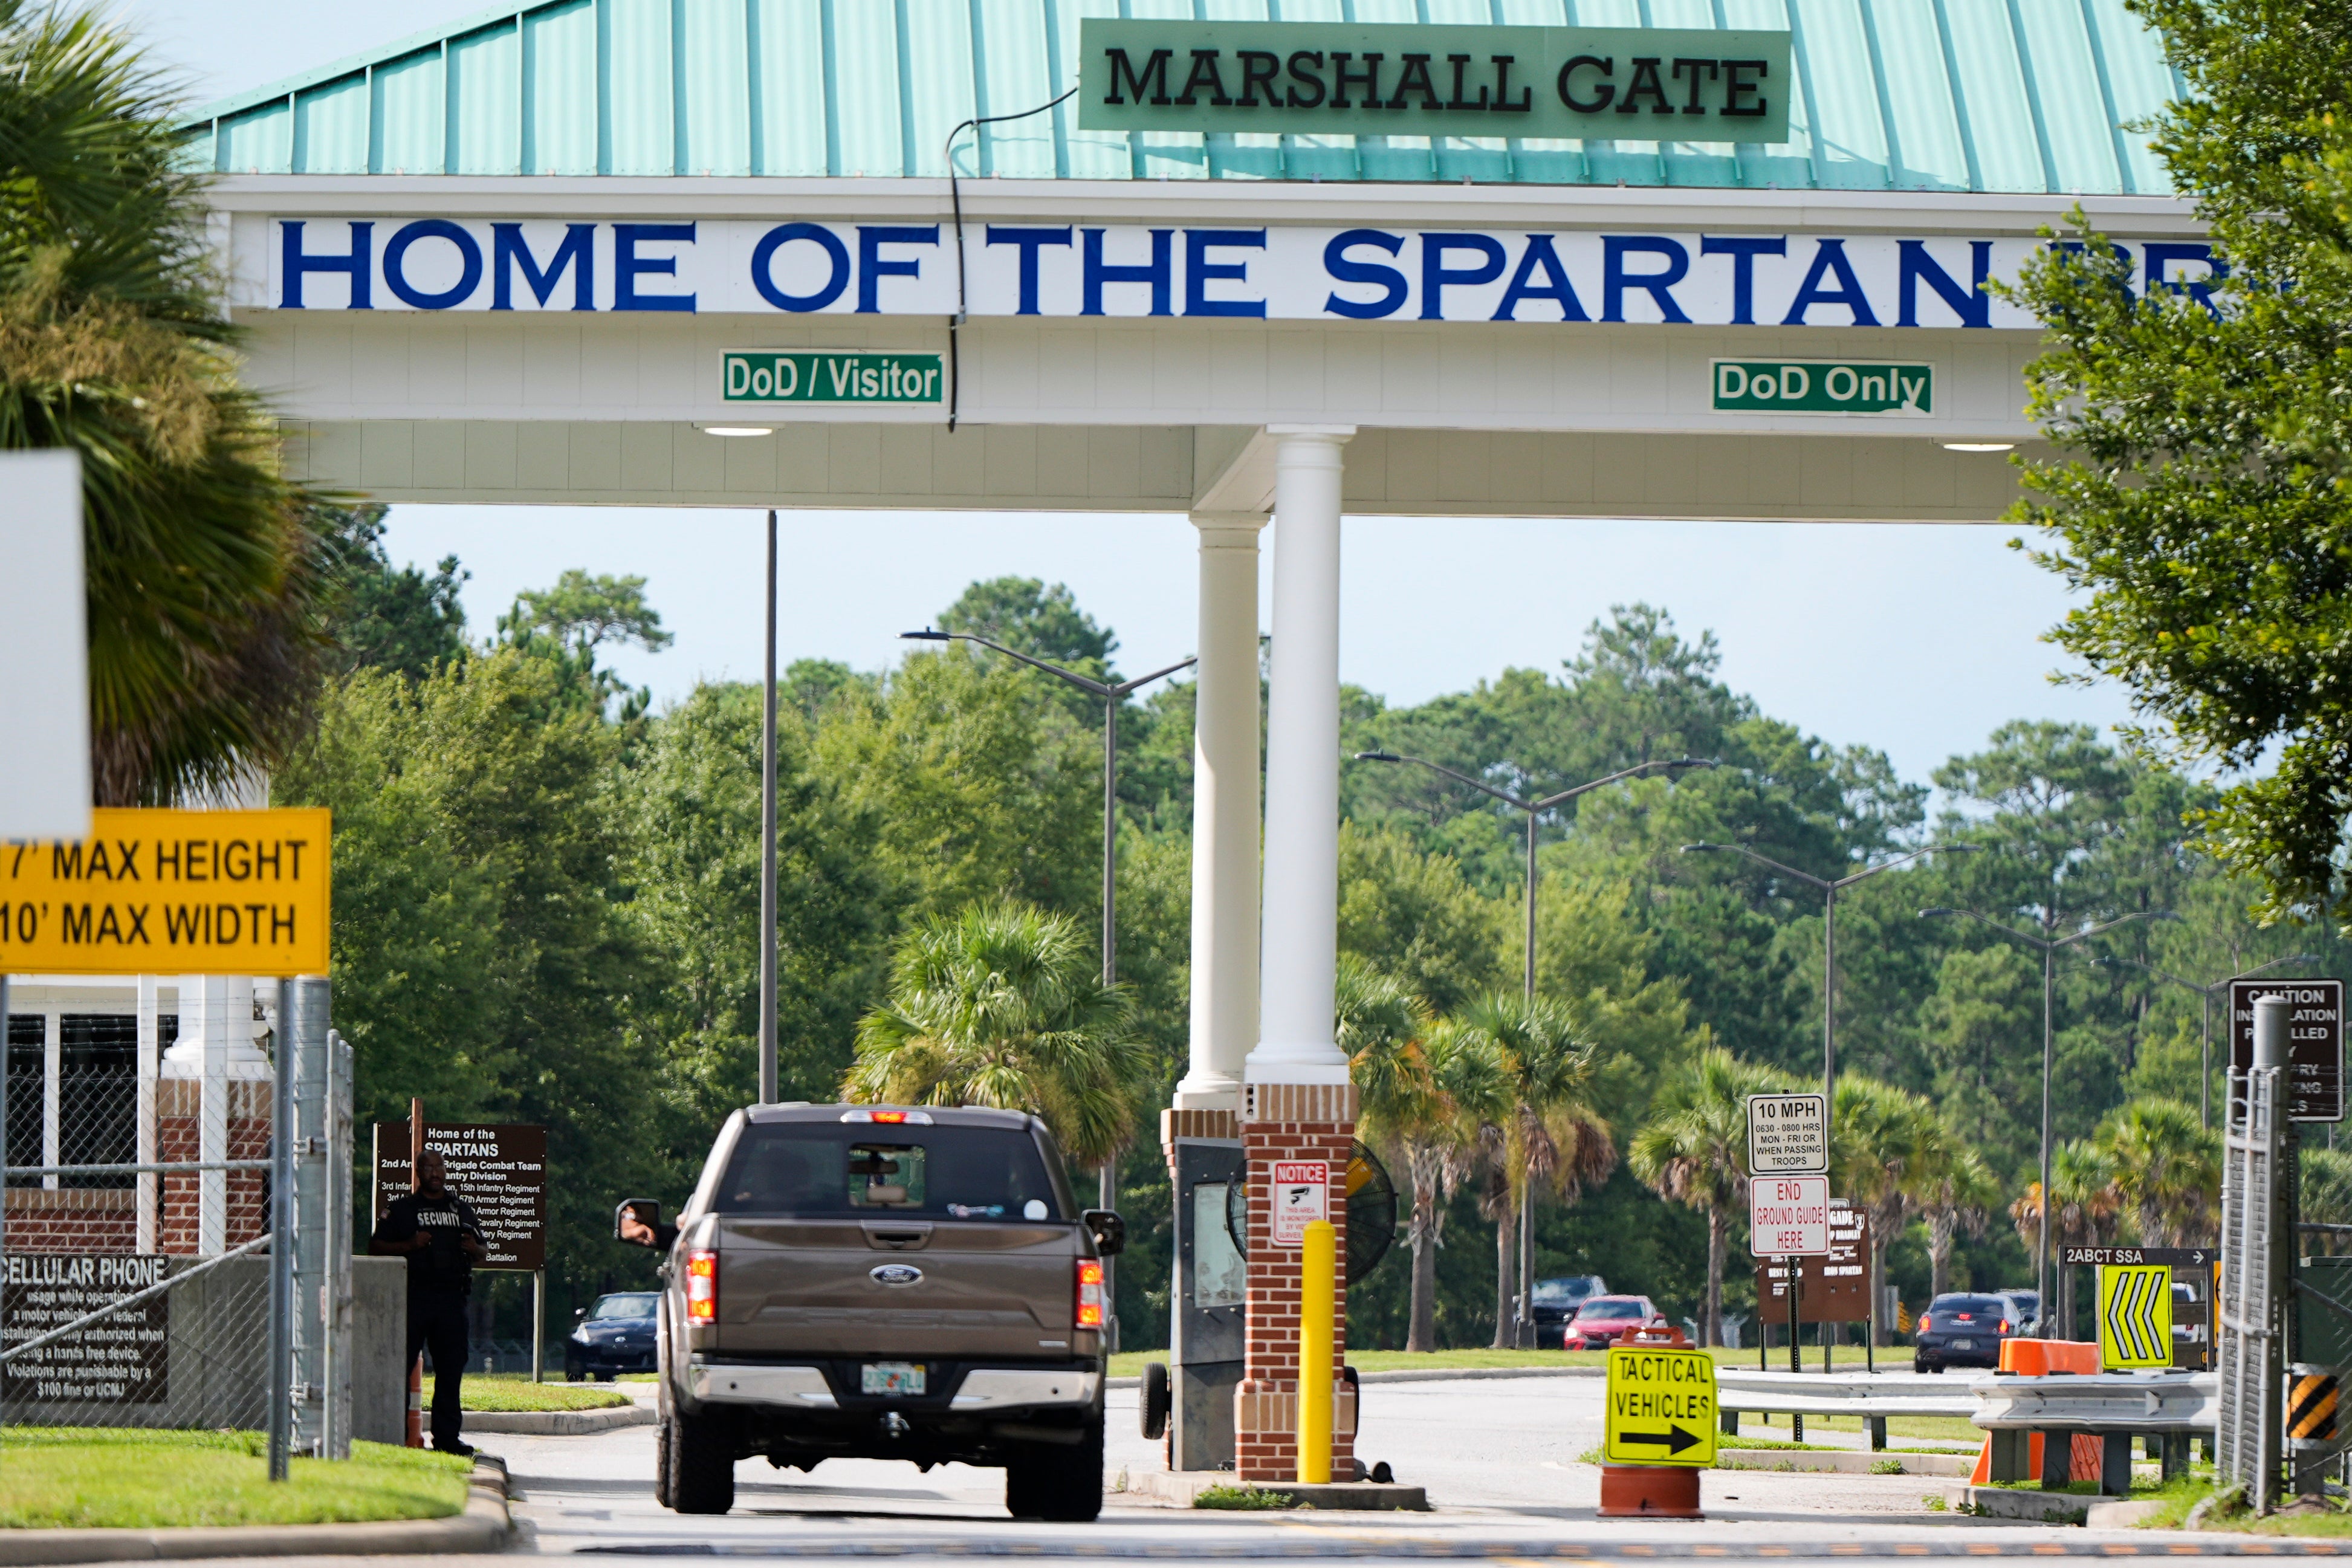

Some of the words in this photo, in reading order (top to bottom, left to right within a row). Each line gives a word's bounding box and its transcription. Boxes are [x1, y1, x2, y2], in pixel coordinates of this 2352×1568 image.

[1104, 48, 1531, 112] MARSHALL
[1558, 56, 1768, 117] GATE
[279, 219, 696, 314] HOME
[751, 222, 940, 314] OF
[986, 224, 1267, 320] THE
[1323, 228, 1993, 328] SPARTAN
[727, 357, 798, 397] DoD
[808, 358, 818, 397] /
[828, 358, 938, 398] Visitor
[1718, 364, 1810, 400] DoD
[1824, 366, 1926, 406] Only
[53, 840, 140, 880] MAX
[157, 840, 308, 880] HEIGHT
[62, 903, 151, 944] MAX
[164, 904, 295, 944] WIDTH
[2244, 1028, 2328, 1039] PLLED
[1758, 1103, 1776, 1118] 10
[1781, 1103, 1816, 1118] MPH
[428, 1128, 459, 1139] Home
[463, 1129, 475, 1139] of
[478, 1129, 495, 1139] the
[1761, 1135, 1780, 1144] MON
[1784, 1145, 1821, 1154] PASSING
[381, 1159, 398, 1168] 2nd
[479, 1161, 515, 1170] Combat
[517, 1162, 541, 1170] Team
[1772, 1156, 1807, 1166] TROOPS
[445, 1172, 468, 1182] antry
[470, 1171, 507, 1181] Division
[1277, 1165, 1324, 1181] NOTICE
[477, 1184, 504, 1194] Infantry
[505, 1184, 540, 1194] Regiment
[1777, 1182, 1801, 1200] END
[500, 1196, 534, 1205] Regiment
[417, 1211, 461, 1228] SECURITY
[476, 1207, 499, 1215] Armor
[501, 1207, 535, 1217] Regiment
[1757, 1207, 1793, 1225] GROUND
[1796, 1207, 1823, 1224] GUIDE
[1830, 1210, 1854, 1225] GADE
[505, 1219, 540, 1228] Regiment
[497, 1230, 532, 1240] Regiment
[1778, 1231, 1803, 1249] HERE
[485, 1253, 517, 1262] Battalion
[2067, 1249, 2111, 1263] 2ABCT
[2115, 1249, 2143, 1263] SSA
[0, 1257, 94, 1286] CELLULAR
[100, 1257, 165, 1286] PHONE
[27, 1291, 56, 1306] usage
[57, 1289, 85, 1304] while
[21, 1307, 51, 1321] motor
[84, 1328, 135, 1341] authorized
[138, 1328, 164, 1342] when
[54, 1345, 84, 1360] hands
[86, 1346, 105, 1359] free
[7, 1363, 55, 1379] Violations
[57, 1366, 73, 1378] are
[75, 1364, 128, 1380] punishable
[130, 1366, 143, 1382] by
[144, 1369, 152, 1380] a
[1619, 1356, 1708, 1383] TACTICAL
[37, 1382, 61, 1398] $100
[63, 1383, 82, 1396] fine
[83, 1385, 95, 1396] or
[96, 1382, 125, 1397] UCMJ
[1616, 1393, 1709, 1419] VEHICLES
